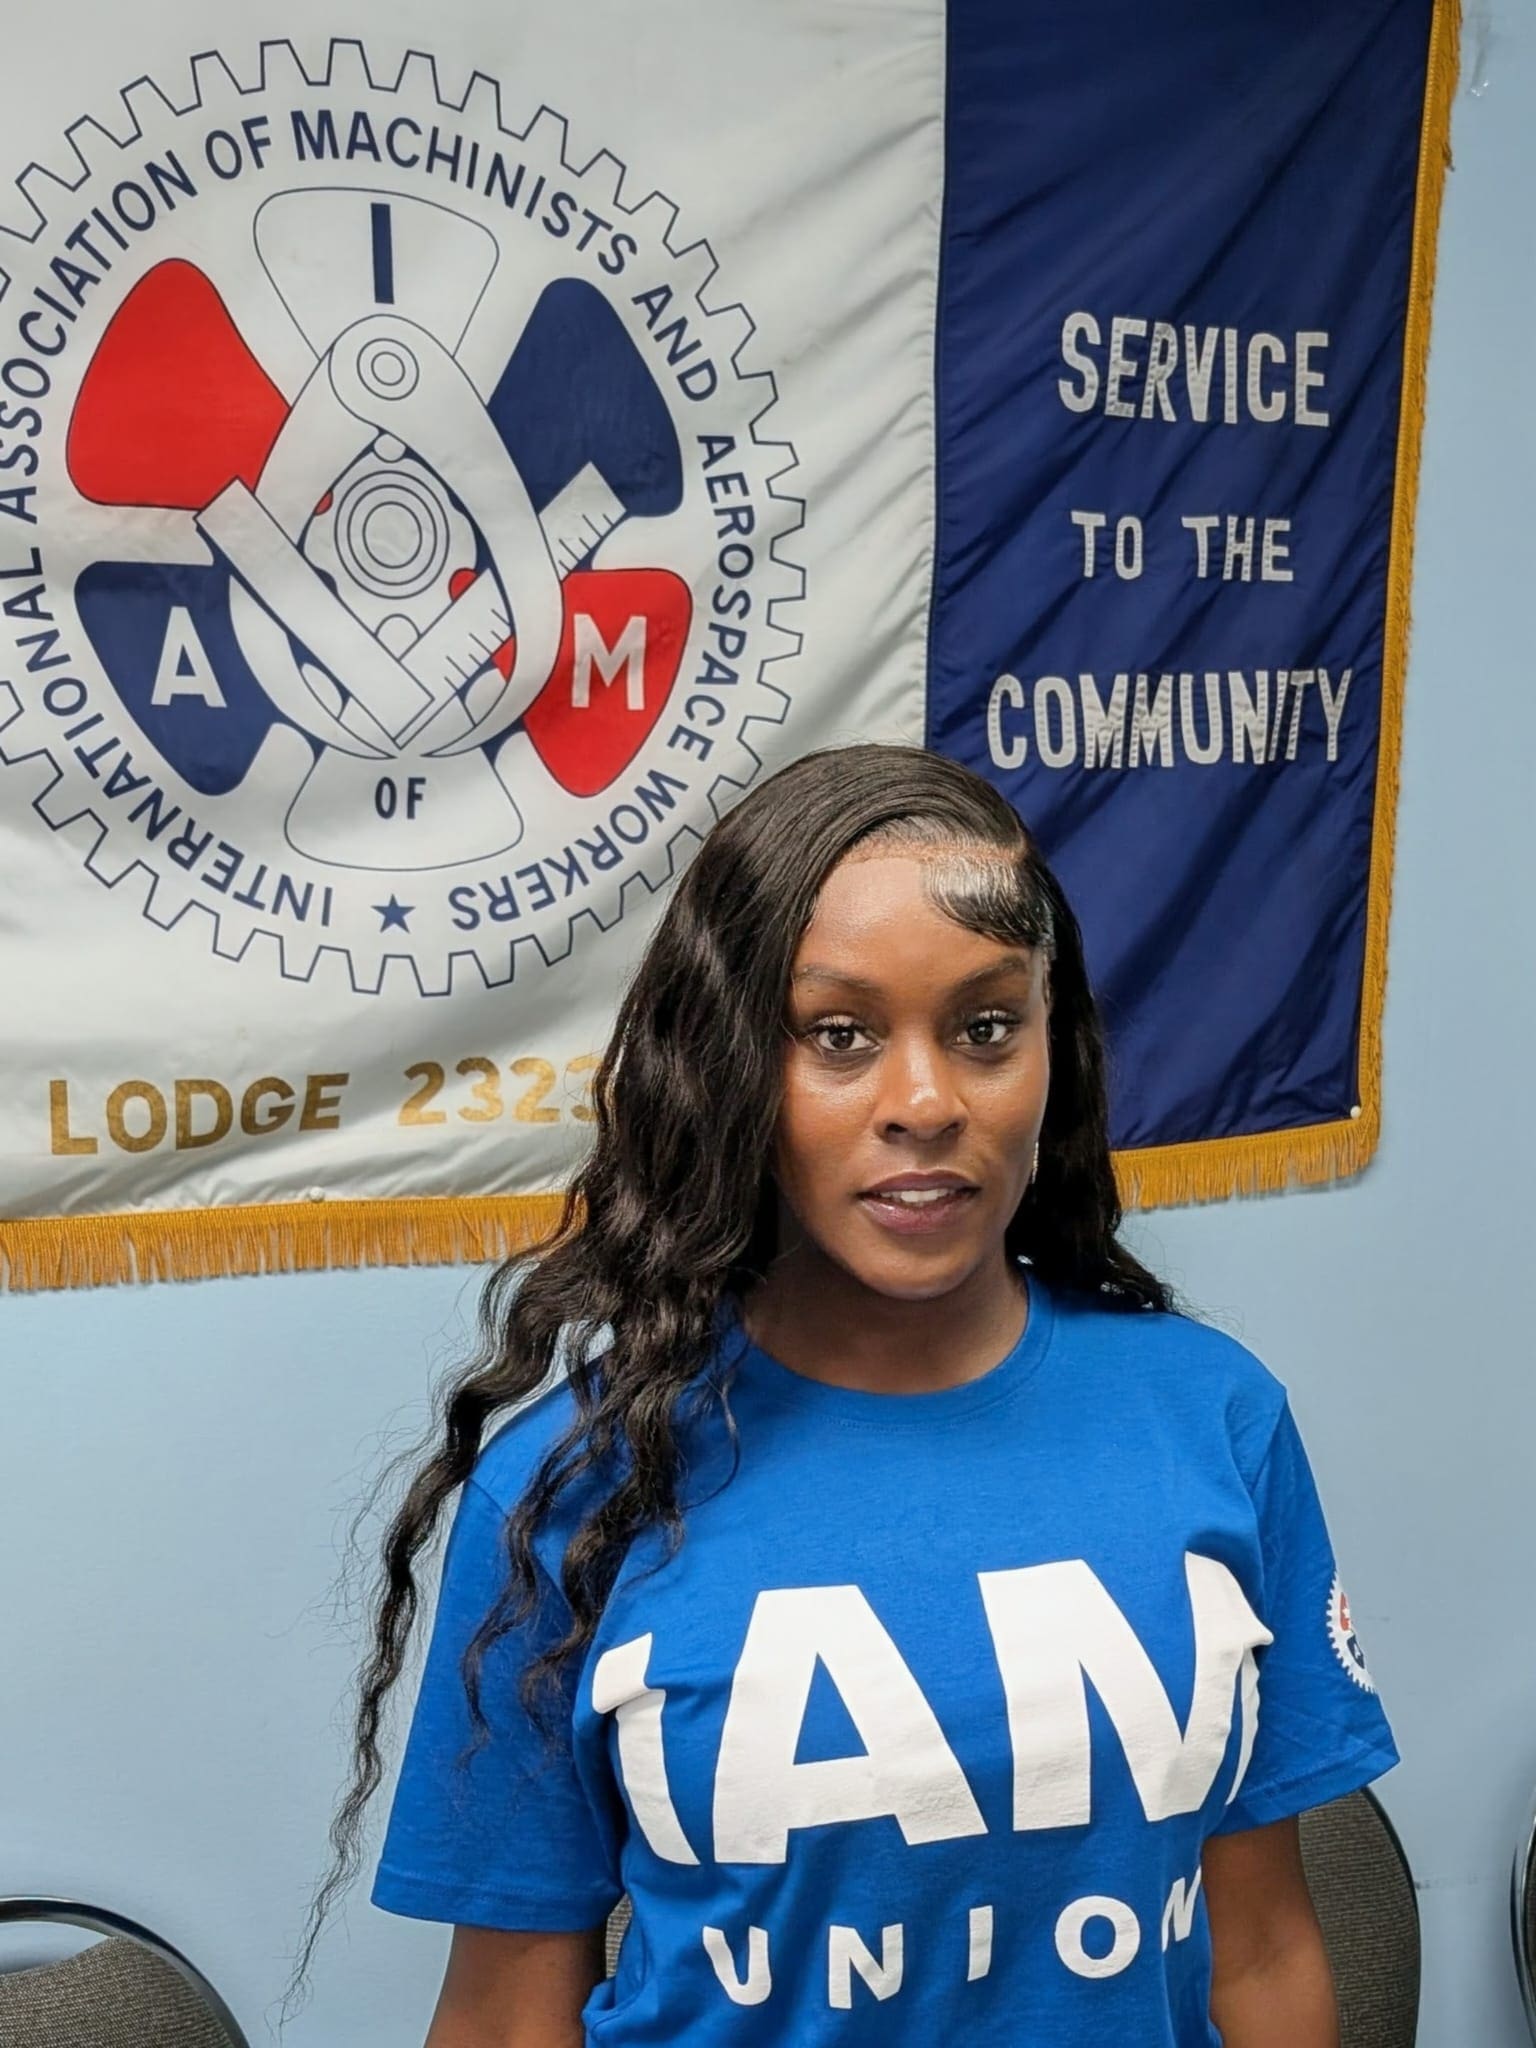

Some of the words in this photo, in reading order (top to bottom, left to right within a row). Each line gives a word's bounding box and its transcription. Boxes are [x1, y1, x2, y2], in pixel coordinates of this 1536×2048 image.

[205, 115, 273, 181] OF
[290, 109, 638, 276] MACHINISTS
[0, 150, 197, 524] ASSOCIATION
[631, 284, 719, 403] AND
[1057, 312, 1330, 427] SERVICE
[666, 434, 756, 763] AEROSPACE
[1071, 510, 1144, 580] TO
[1181, 515, 1294, 582] THE
[150, 605, 228, 708] A
[571, 613, 647, 711] M
[0, 546, 333, 927] INTERNATIONAL
[986, 668, 1353, 770] COMMUNITY
[374, 776, 427, 821] OF
[447, 768, 690, 931] WORKERS
[49, 1072, 350, 1156] LODGE
[702, 1864, 1201, 2008] UNION
